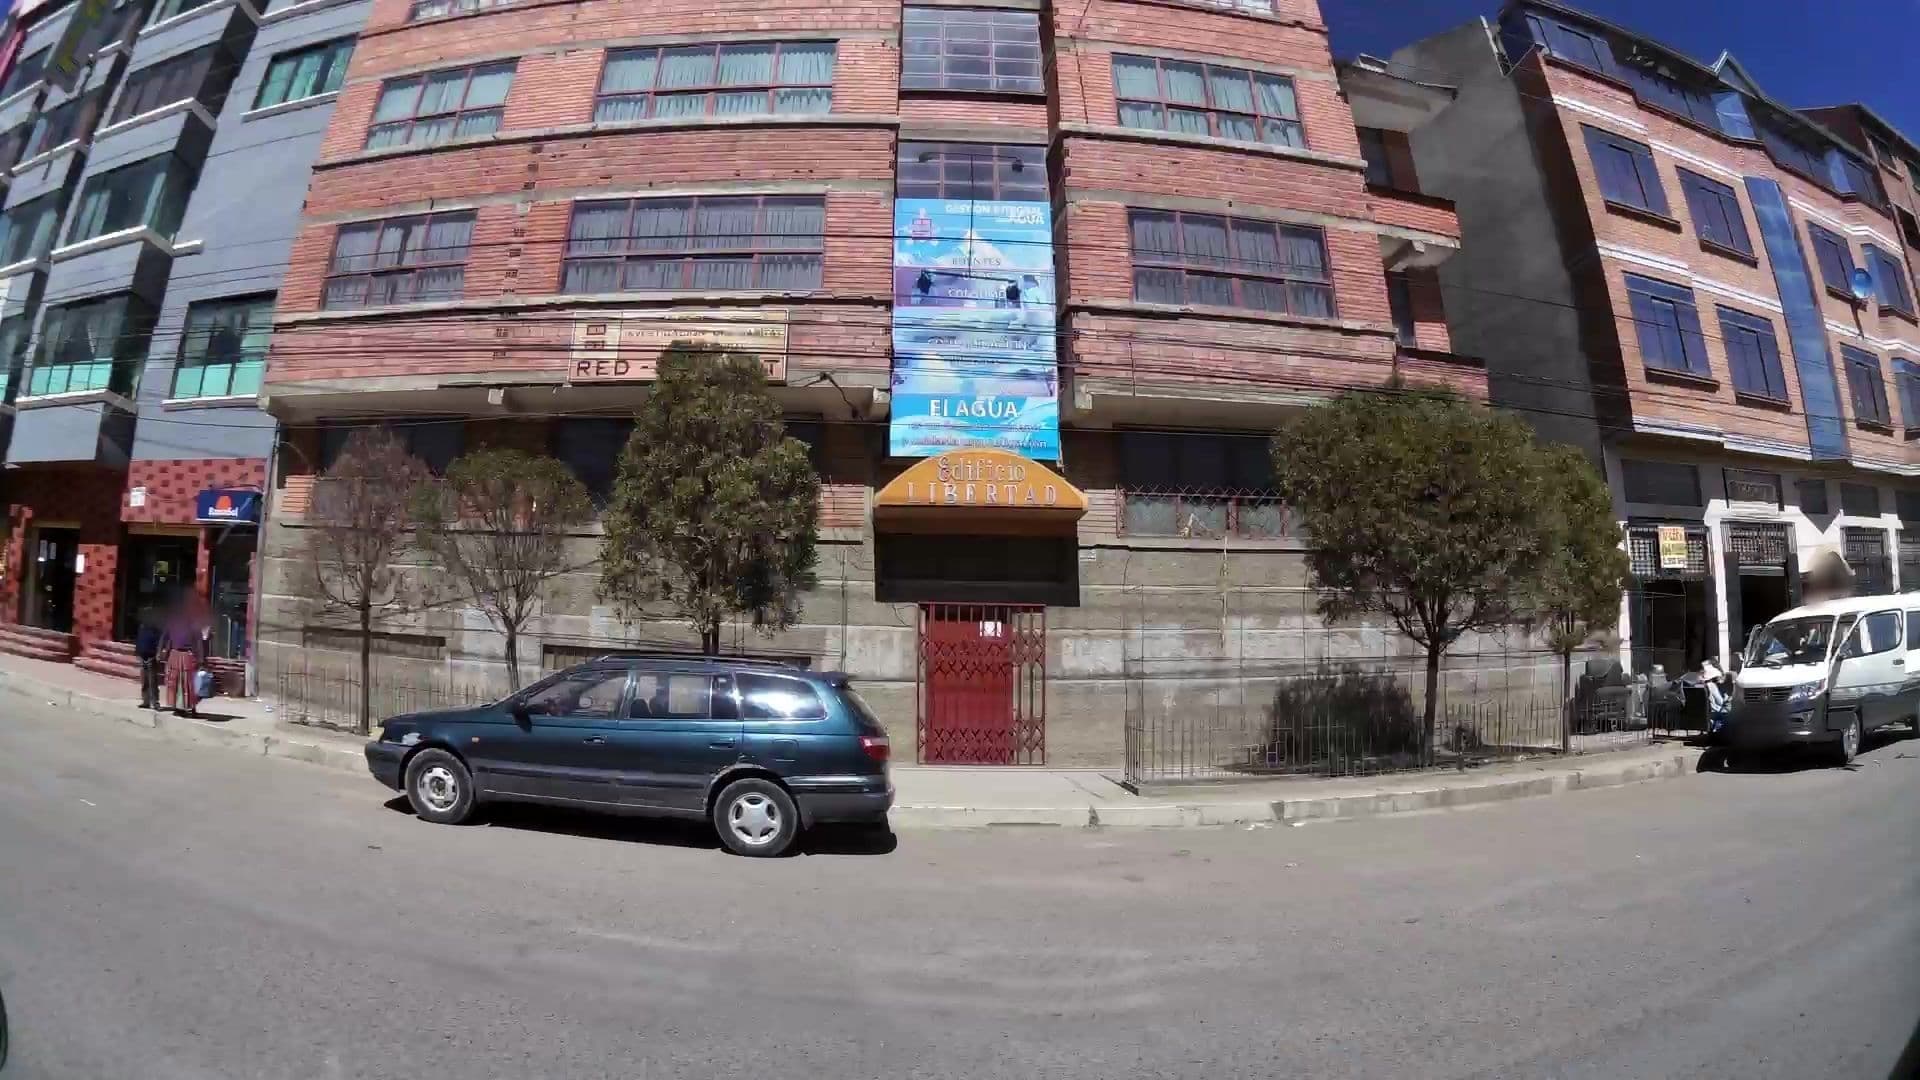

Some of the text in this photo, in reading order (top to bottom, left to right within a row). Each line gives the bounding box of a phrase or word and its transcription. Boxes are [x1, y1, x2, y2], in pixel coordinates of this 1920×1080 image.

[576, 360, 630, 377] RED
[955, 399, 1018, 418] AGUA
[937, 455, 1026, 483] Edificio
[906, 482, 1058, 506] LIBERTAD
